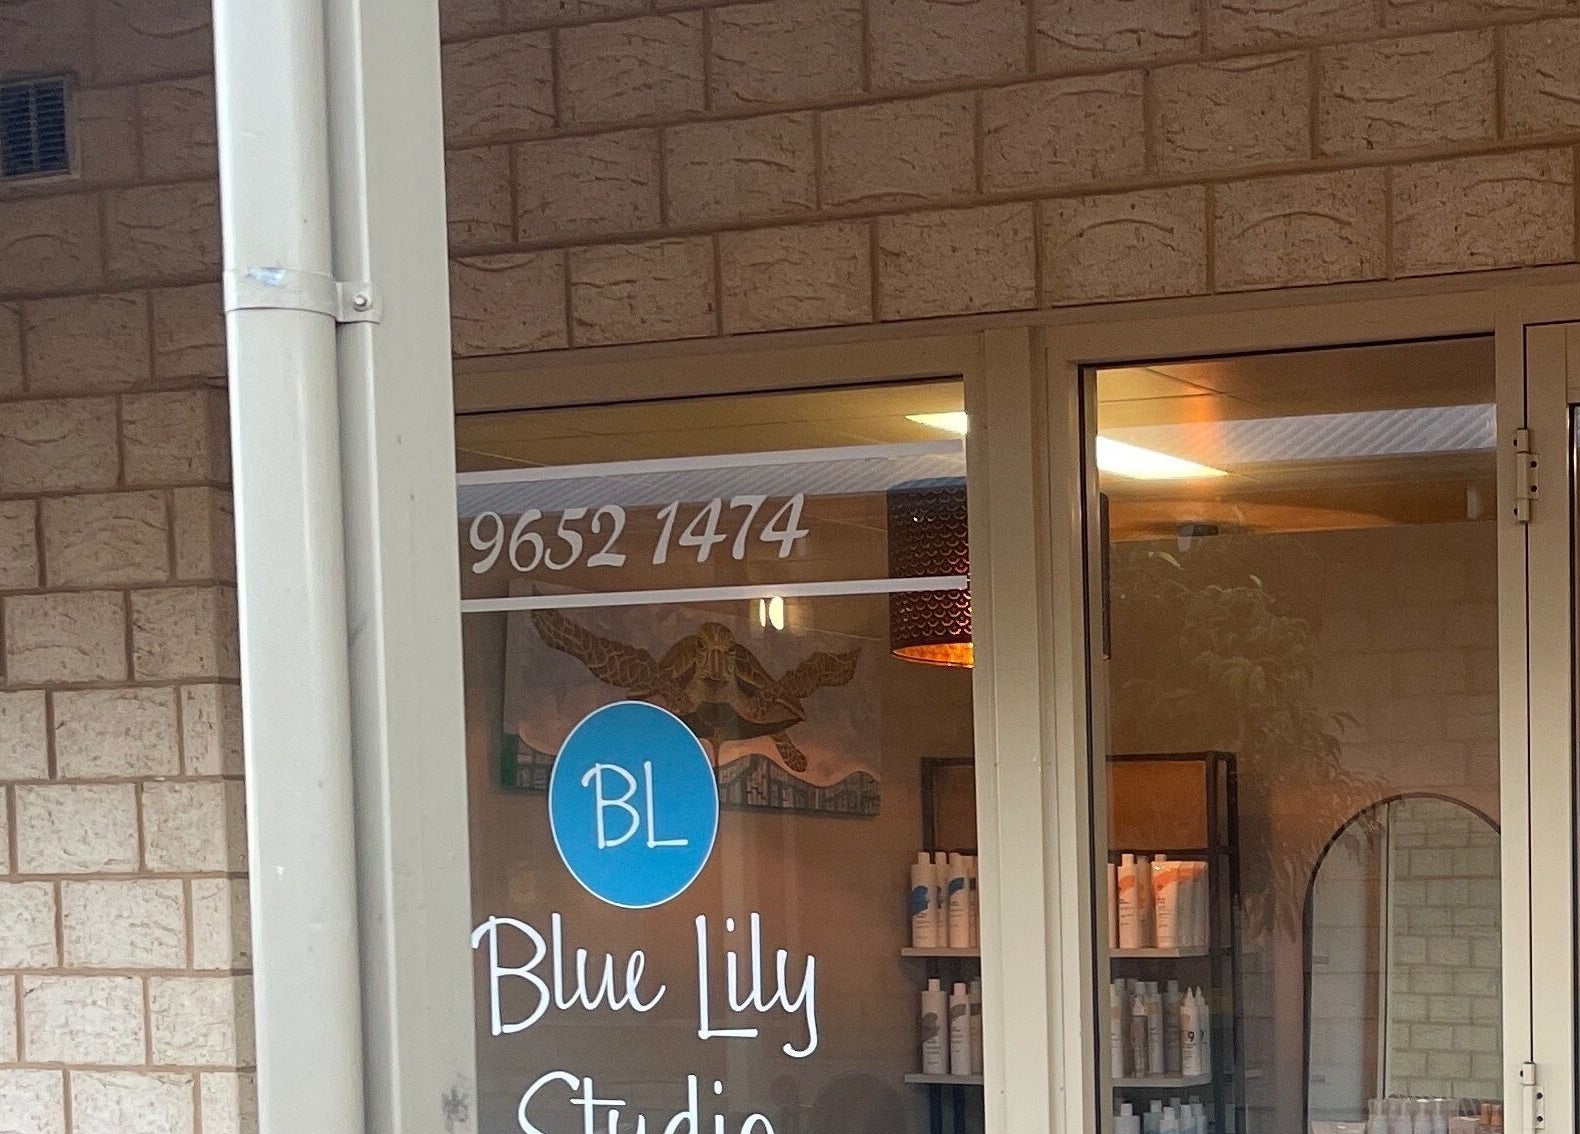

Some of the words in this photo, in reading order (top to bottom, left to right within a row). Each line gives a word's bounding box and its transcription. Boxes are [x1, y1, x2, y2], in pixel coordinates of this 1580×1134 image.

[469, 503, 627, 575] 9652
[653, 493, 810, 567] 1474
[581, 761, 689, 850] BL
[471, 912, 667, 1037] Blue
[695, 912, 819, 1059] Lily
